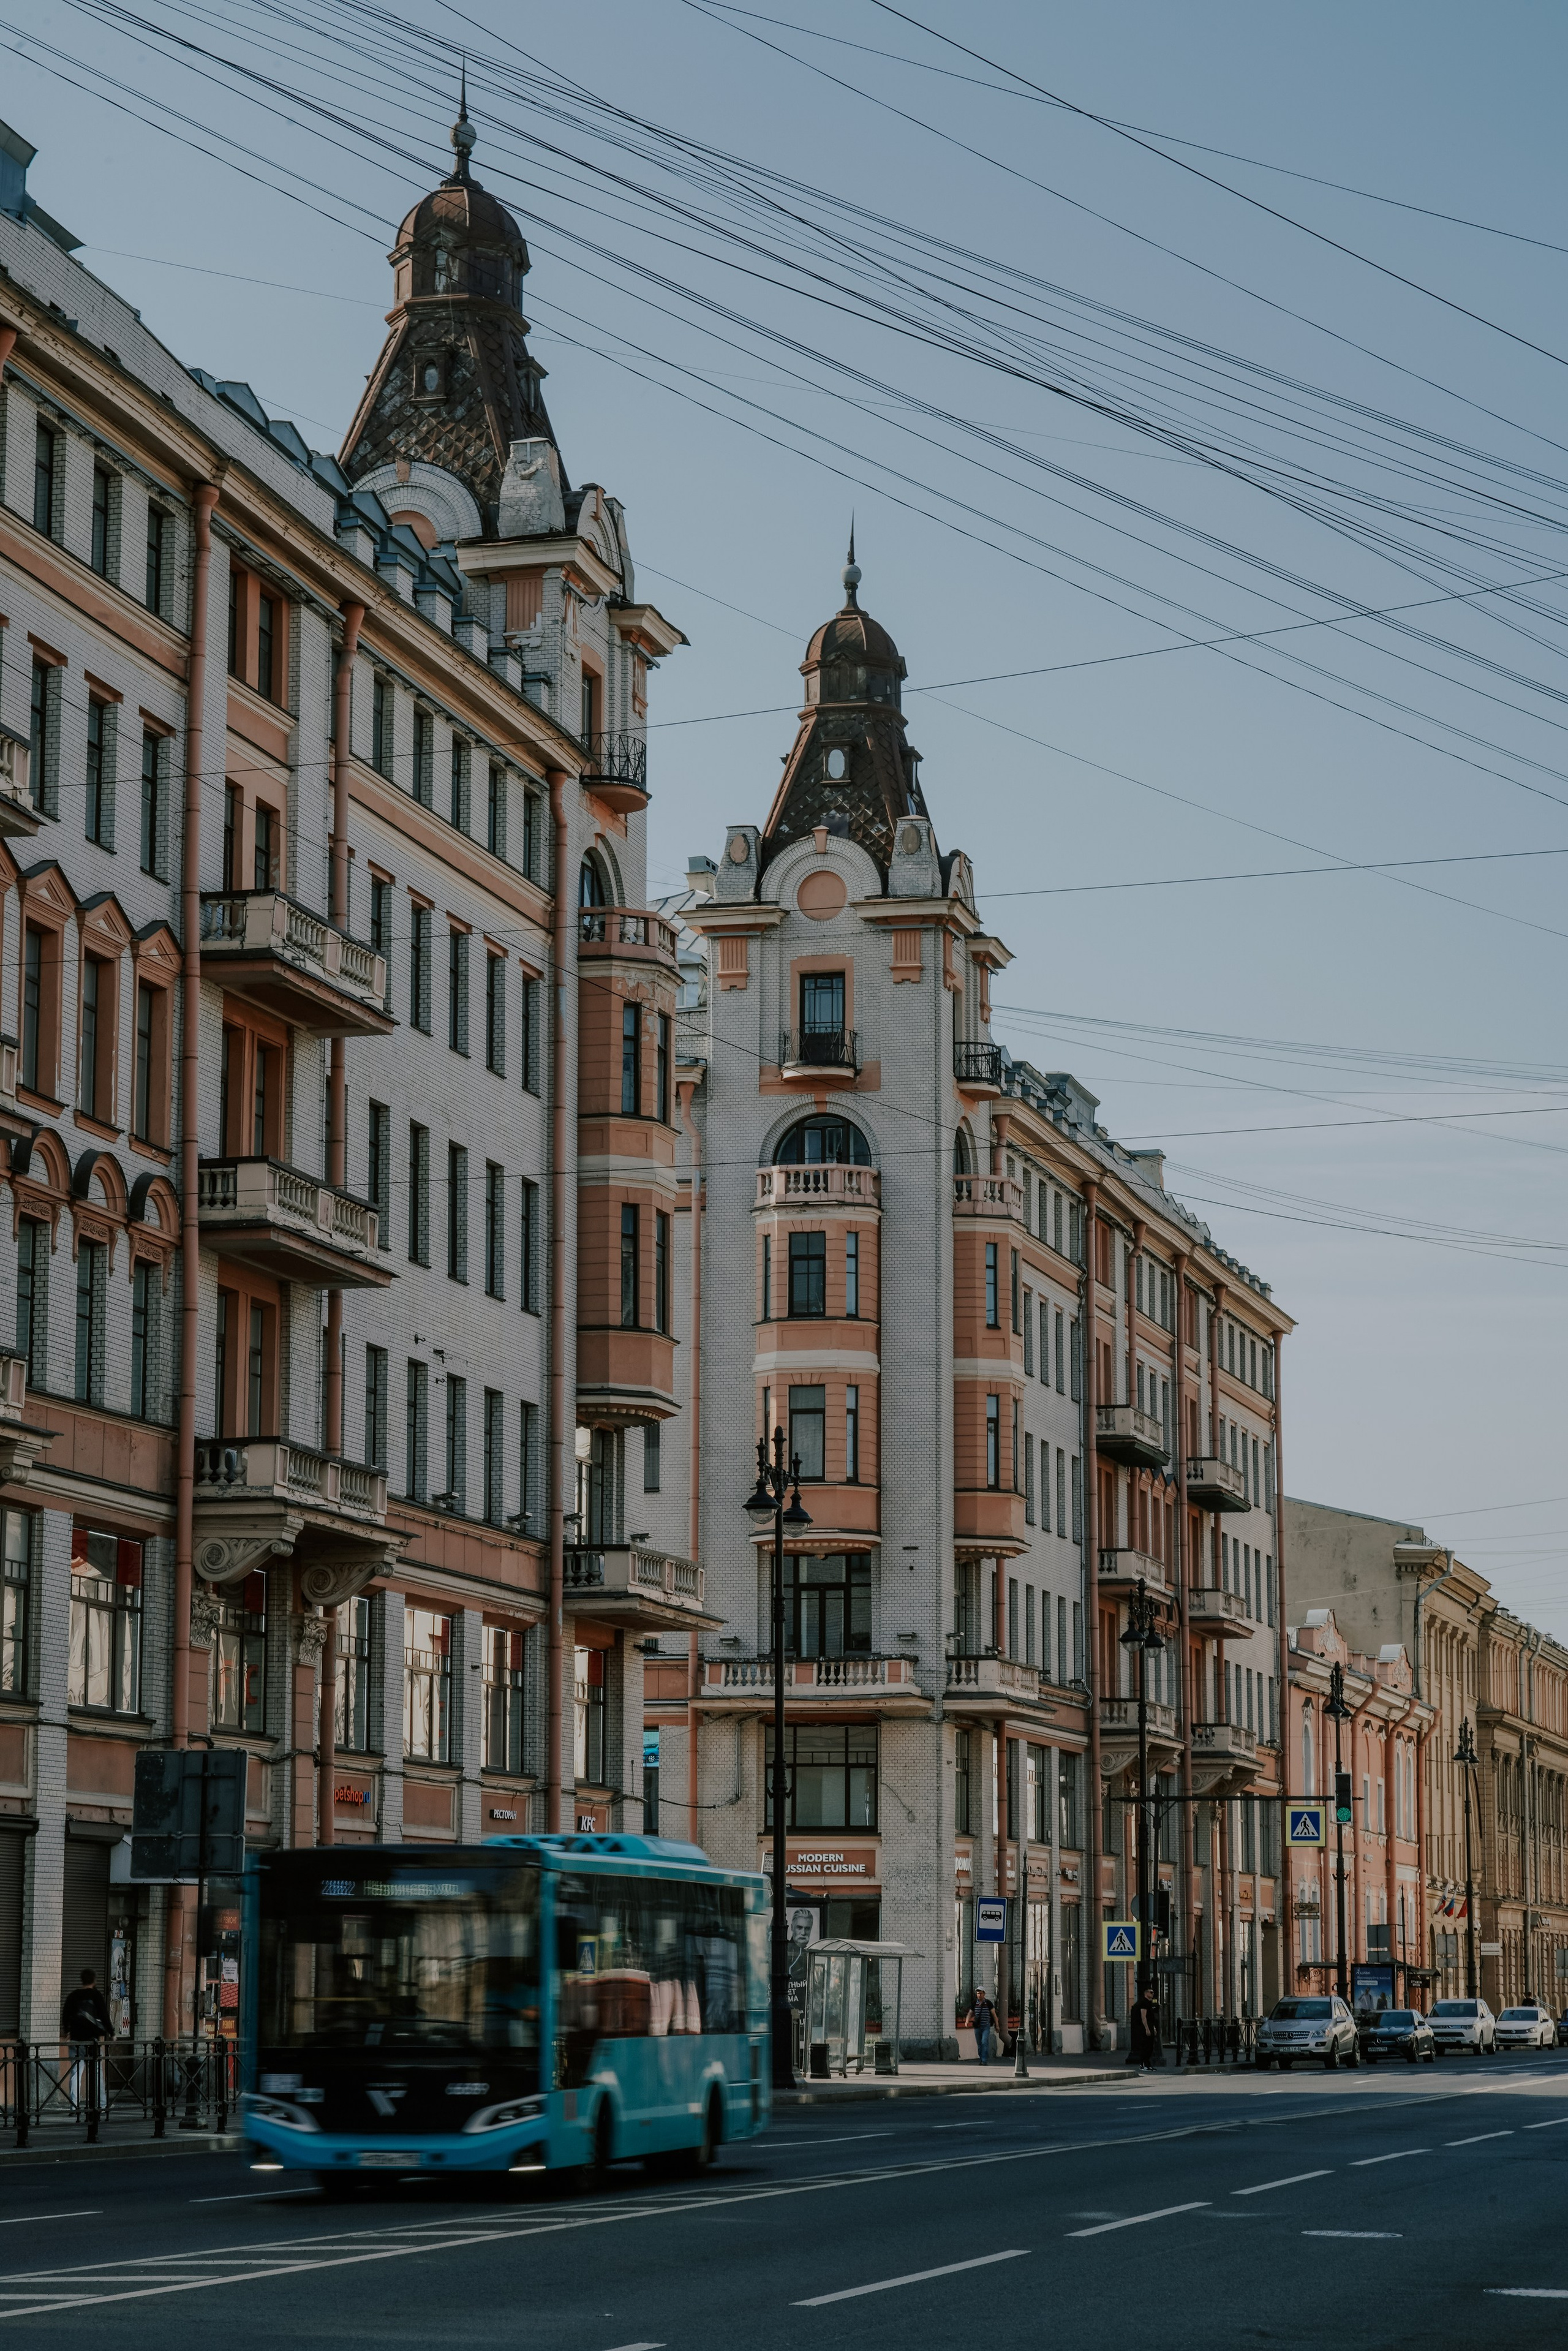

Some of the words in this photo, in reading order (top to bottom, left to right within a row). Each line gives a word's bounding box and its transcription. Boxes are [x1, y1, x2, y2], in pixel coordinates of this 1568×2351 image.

[494, 1809, 517, 1820] РЕСТОРАН
[581, 1816, 596, 1832] KFC
[798, 1854, 843, 1862] MODERN
[786, 1864, 821, 1873] USSIAN
[823, 1864, 865, 1873] CUISINE
[955, 1857, 972, 1874] ремок
